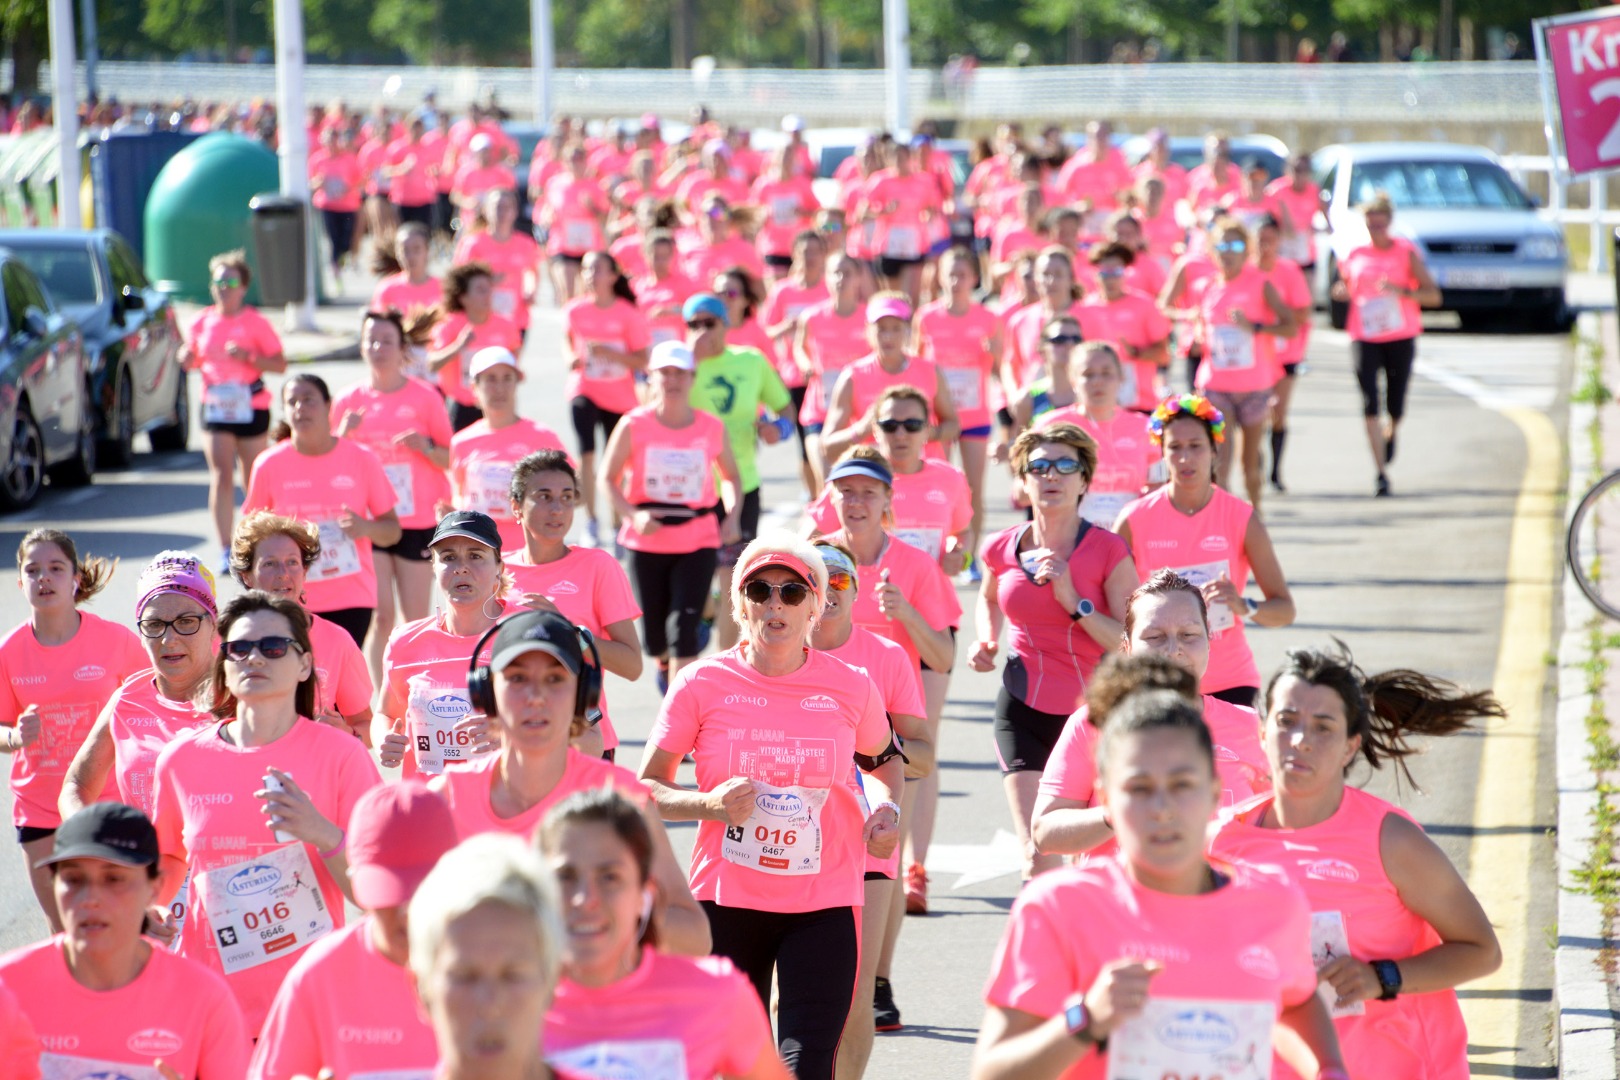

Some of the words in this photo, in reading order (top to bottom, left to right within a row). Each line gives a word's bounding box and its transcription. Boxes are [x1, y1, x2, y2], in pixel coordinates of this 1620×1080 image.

[11, 675, 47, 686] OYSHO
[724, 694, 768, 708] OYSHO
[803, 700, 838, 709] ASTURIANA
[431, 704, 468, 713] ASTURIANA
[436, 730, 469, 746] 016
[444, 749, 461, 757] 5552
[760, 746, 789, 756] VITORIA
[795, 748, 825, 757] GASTEIZ
[775, 755, 805, 764] MADRID
[188, 793, 233, 806] OYSHO
[760, 797, 800, 812] ASTURIANA
[754, 825, 797, 845] 016
[725, 847, 750, 860] OYSHO
[762, 845, 785, 856] 6467
[232, 872, 279, 893] ASTURIANA
[243, 901, 290, 930] 016
[260, 925, 285, 940] 6646
[227, 951, 255, 964] OYSHO
[338, 1028, 403, 1045] OYSHO
